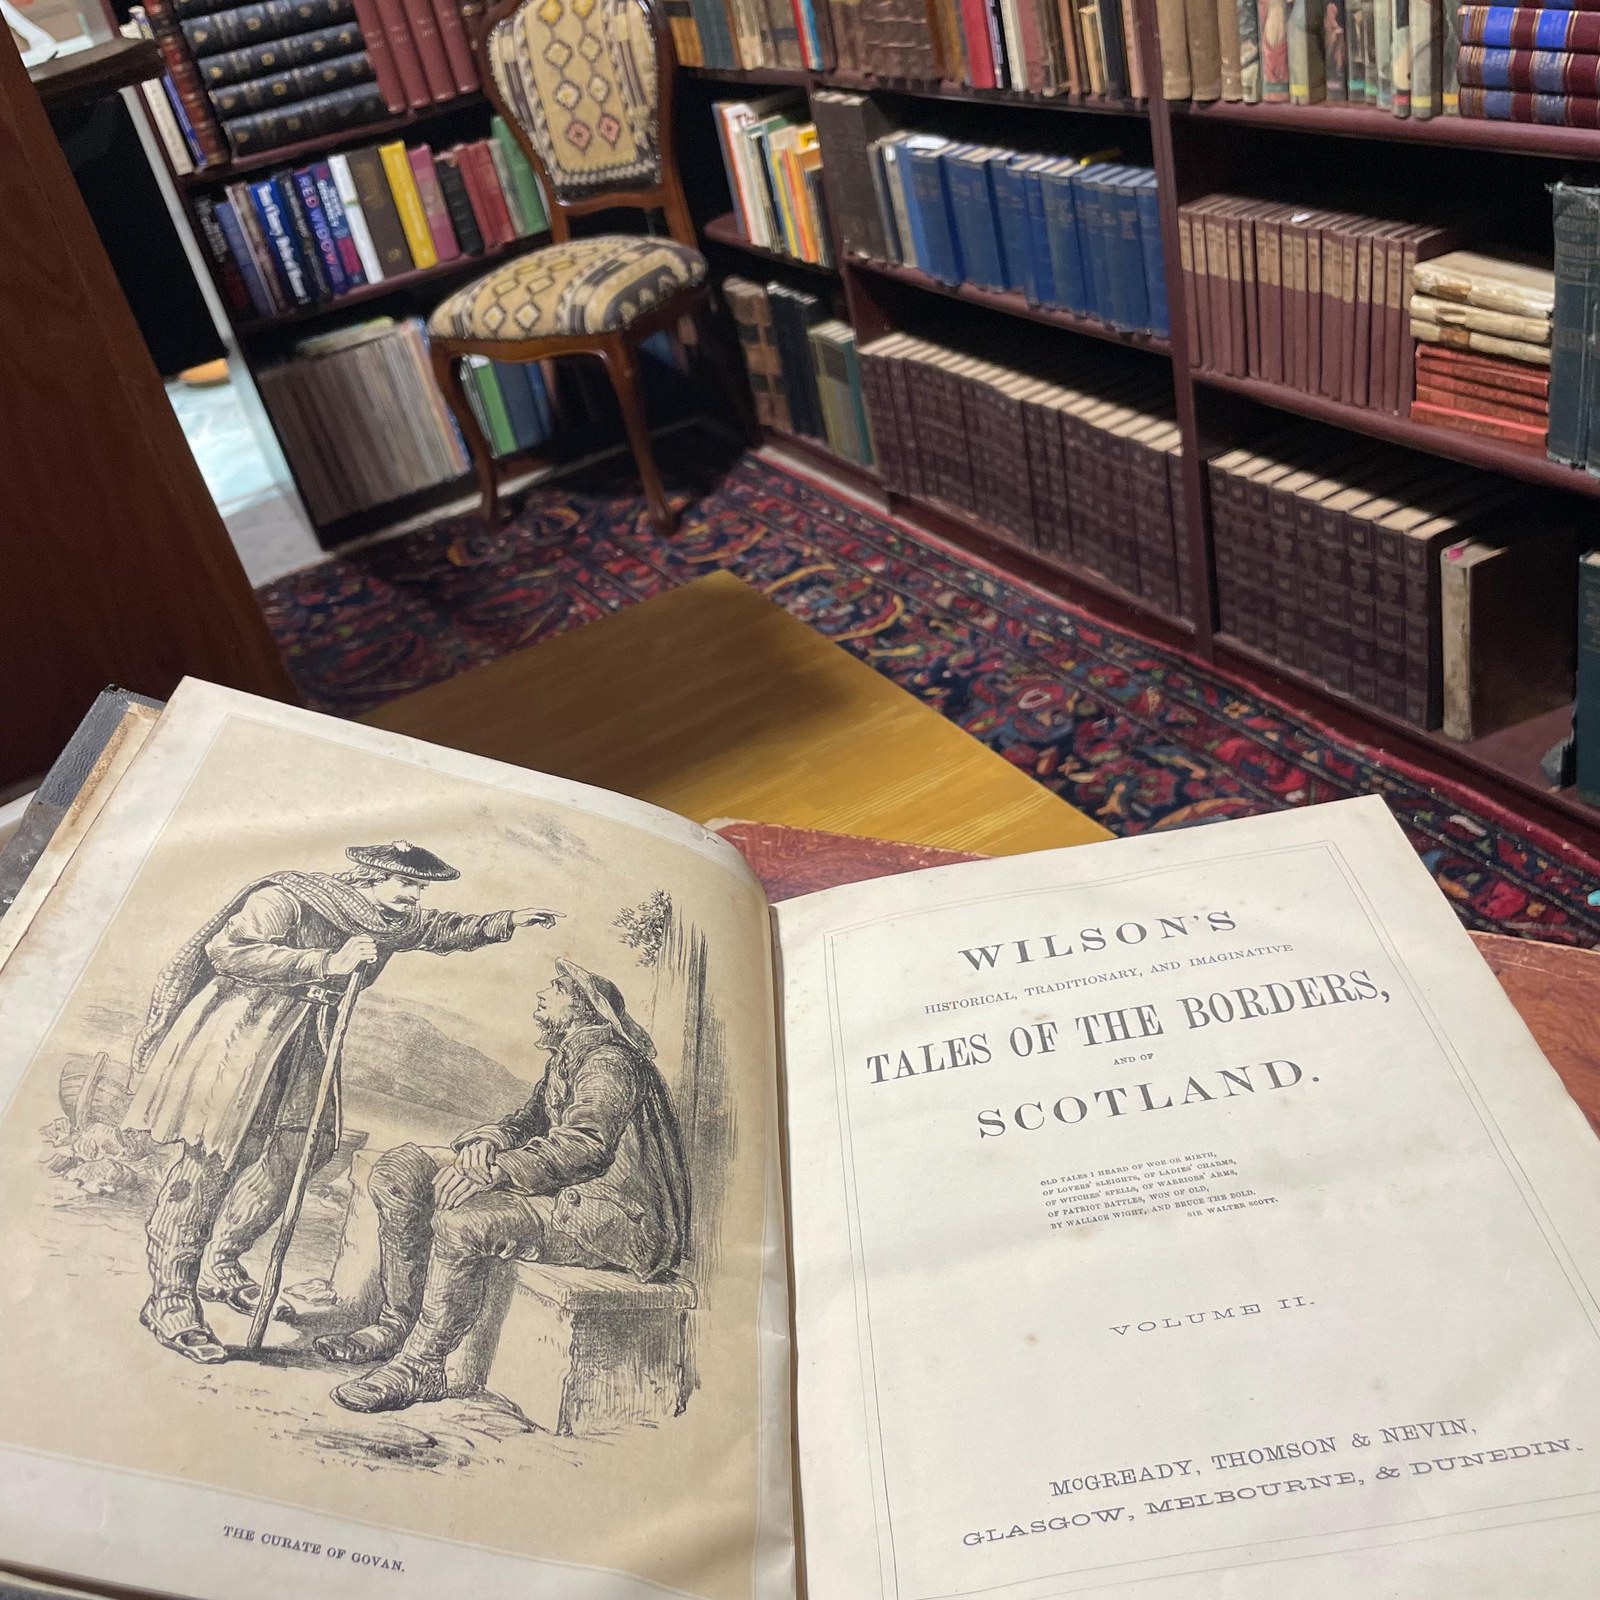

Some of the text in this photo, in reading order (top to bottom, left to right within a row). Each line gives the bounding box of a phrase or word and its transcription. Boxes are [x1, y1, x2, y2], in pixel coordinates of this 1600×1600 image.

[298, 174, 320, 209] RED
[309, 208, 337, 266] WIDOW
[957, 910, 1237, 971] WILSON'S
[924, 944, 1294, 1015] HISTORICAL, TRADITIONARY, AND IMAGINATIVE
[866, 969, 1391, 1085] TALES OF THE BORDERS,
[1112, 1052, 1154, 1066] AND OF
[977, 1058, 1321, 1140] SCOTLAND.
[1040, 1178, 1058, 1187] OLD
[1060, 1173, 1088, 1183] TALES
[1097, 1166, 1129, 1177] HEARD
[1131, 1163, 1143, 1171] OF
[1146, 1160, 1167, 1168] WOE
[1184, 1151, 1218, 1163] MIRTH,
[1042, 1158, 1237, 1197] OF LOVERS' SLEIGHTS, OF LADIES' CHARMS,
[1045, 1169, 1238, 1207] OF WITCHES' SPELLS, OF WARRIORS' ARMS,
[1047, 1184, 1210, 1218] OF PATRIOT BATTLES, WON OF OLD,
[1049, 1189, 1257, 1230] BY WALLACE WIGHT, AND BRUCE THE BOLD.
[1186, 1196, 1279, 1218] SIR WALTER SCOTT.
[1108, 1295, 1316, 1336] VOLUME II.
[1210, 1436, 1337, 1471] THOMSON
[1351, 1432, 1371, 1449] &
[1378, 1417, 1478, 1444] NEVIN,
[962, 1438, 1585, 1547] GLASGOW, MELBOURNE, & DUNEDIN.
[223, 1525, 406, 1573] THE CURATE OF GOVAN.
